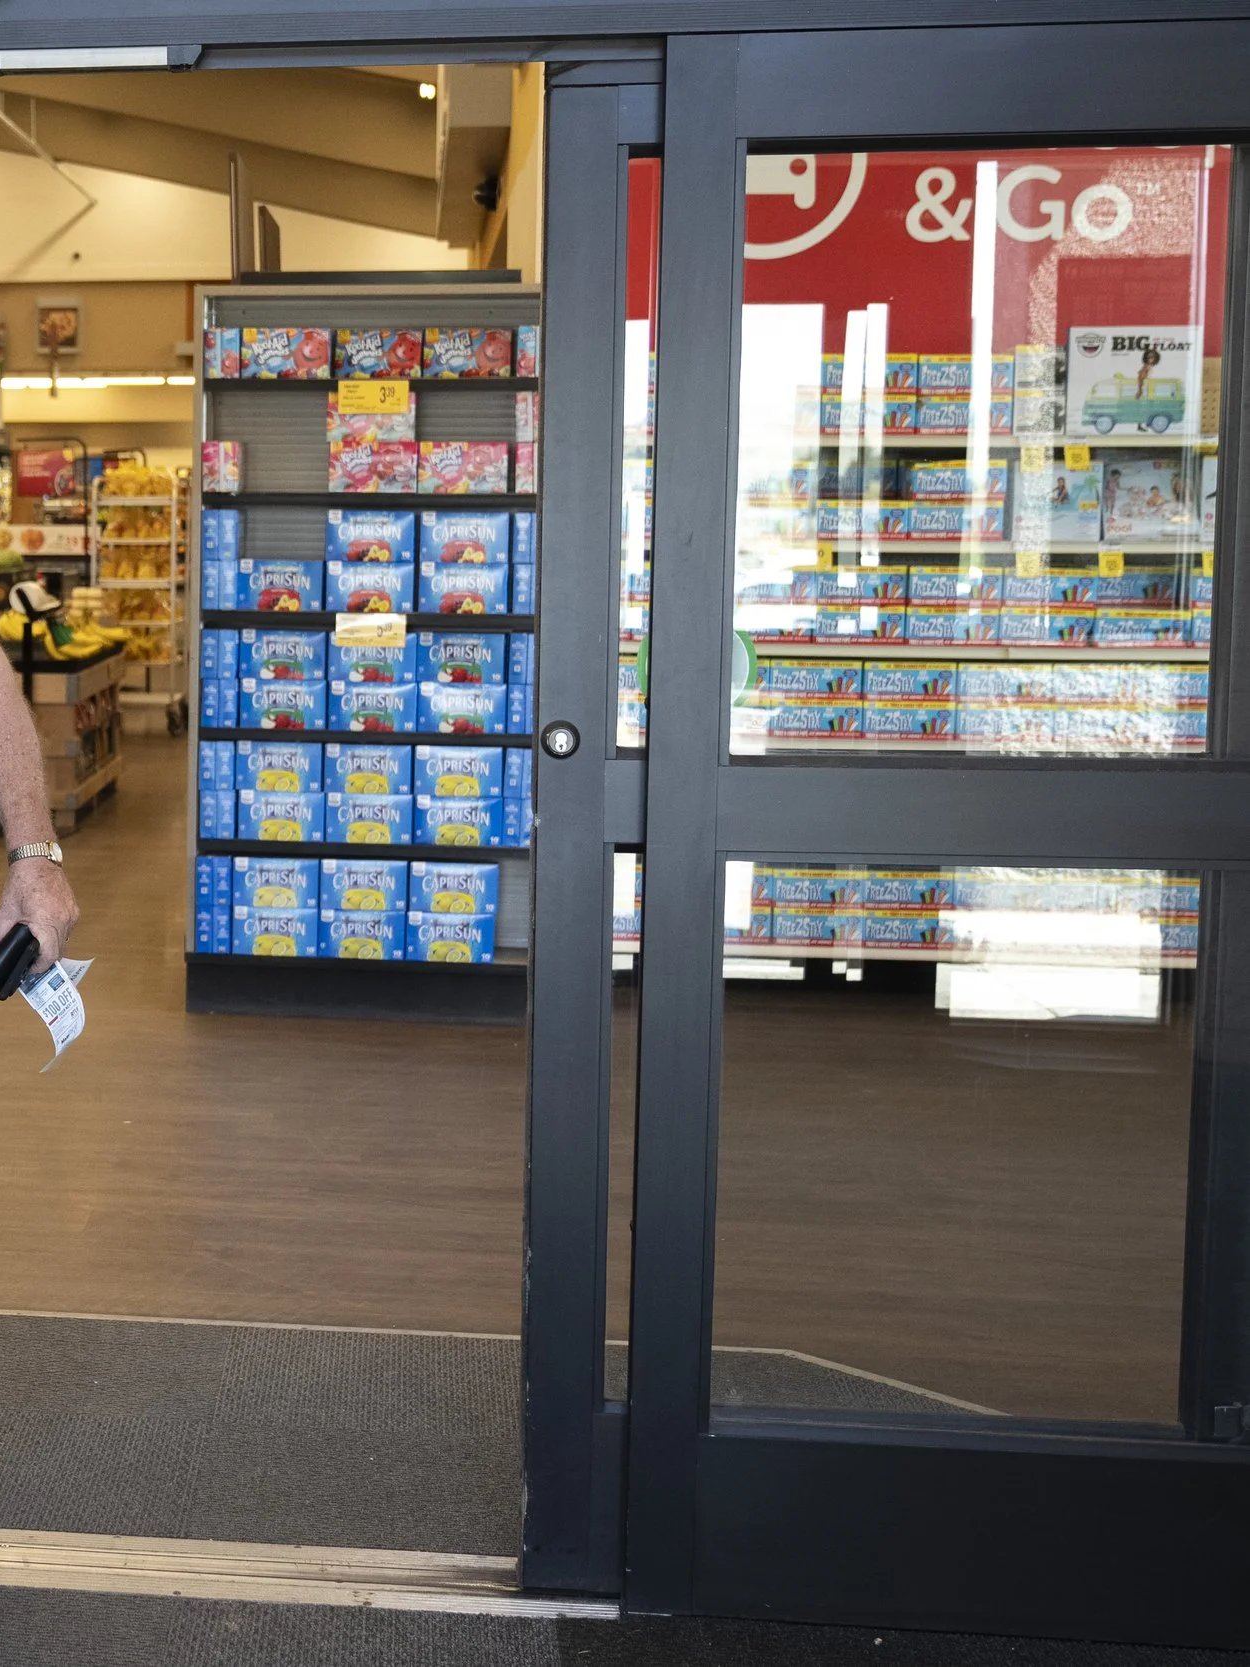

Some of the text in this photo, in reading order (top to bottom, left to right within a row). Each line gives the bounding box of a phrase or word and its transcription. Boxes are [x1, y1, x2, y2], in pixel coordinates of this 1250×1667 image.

[905, 166, 973, 243] &
[1111, 336, 1150, 351] BIG
[42, 1000, 61, 1018] $100
[58, 987, 73, 1006] OFF
